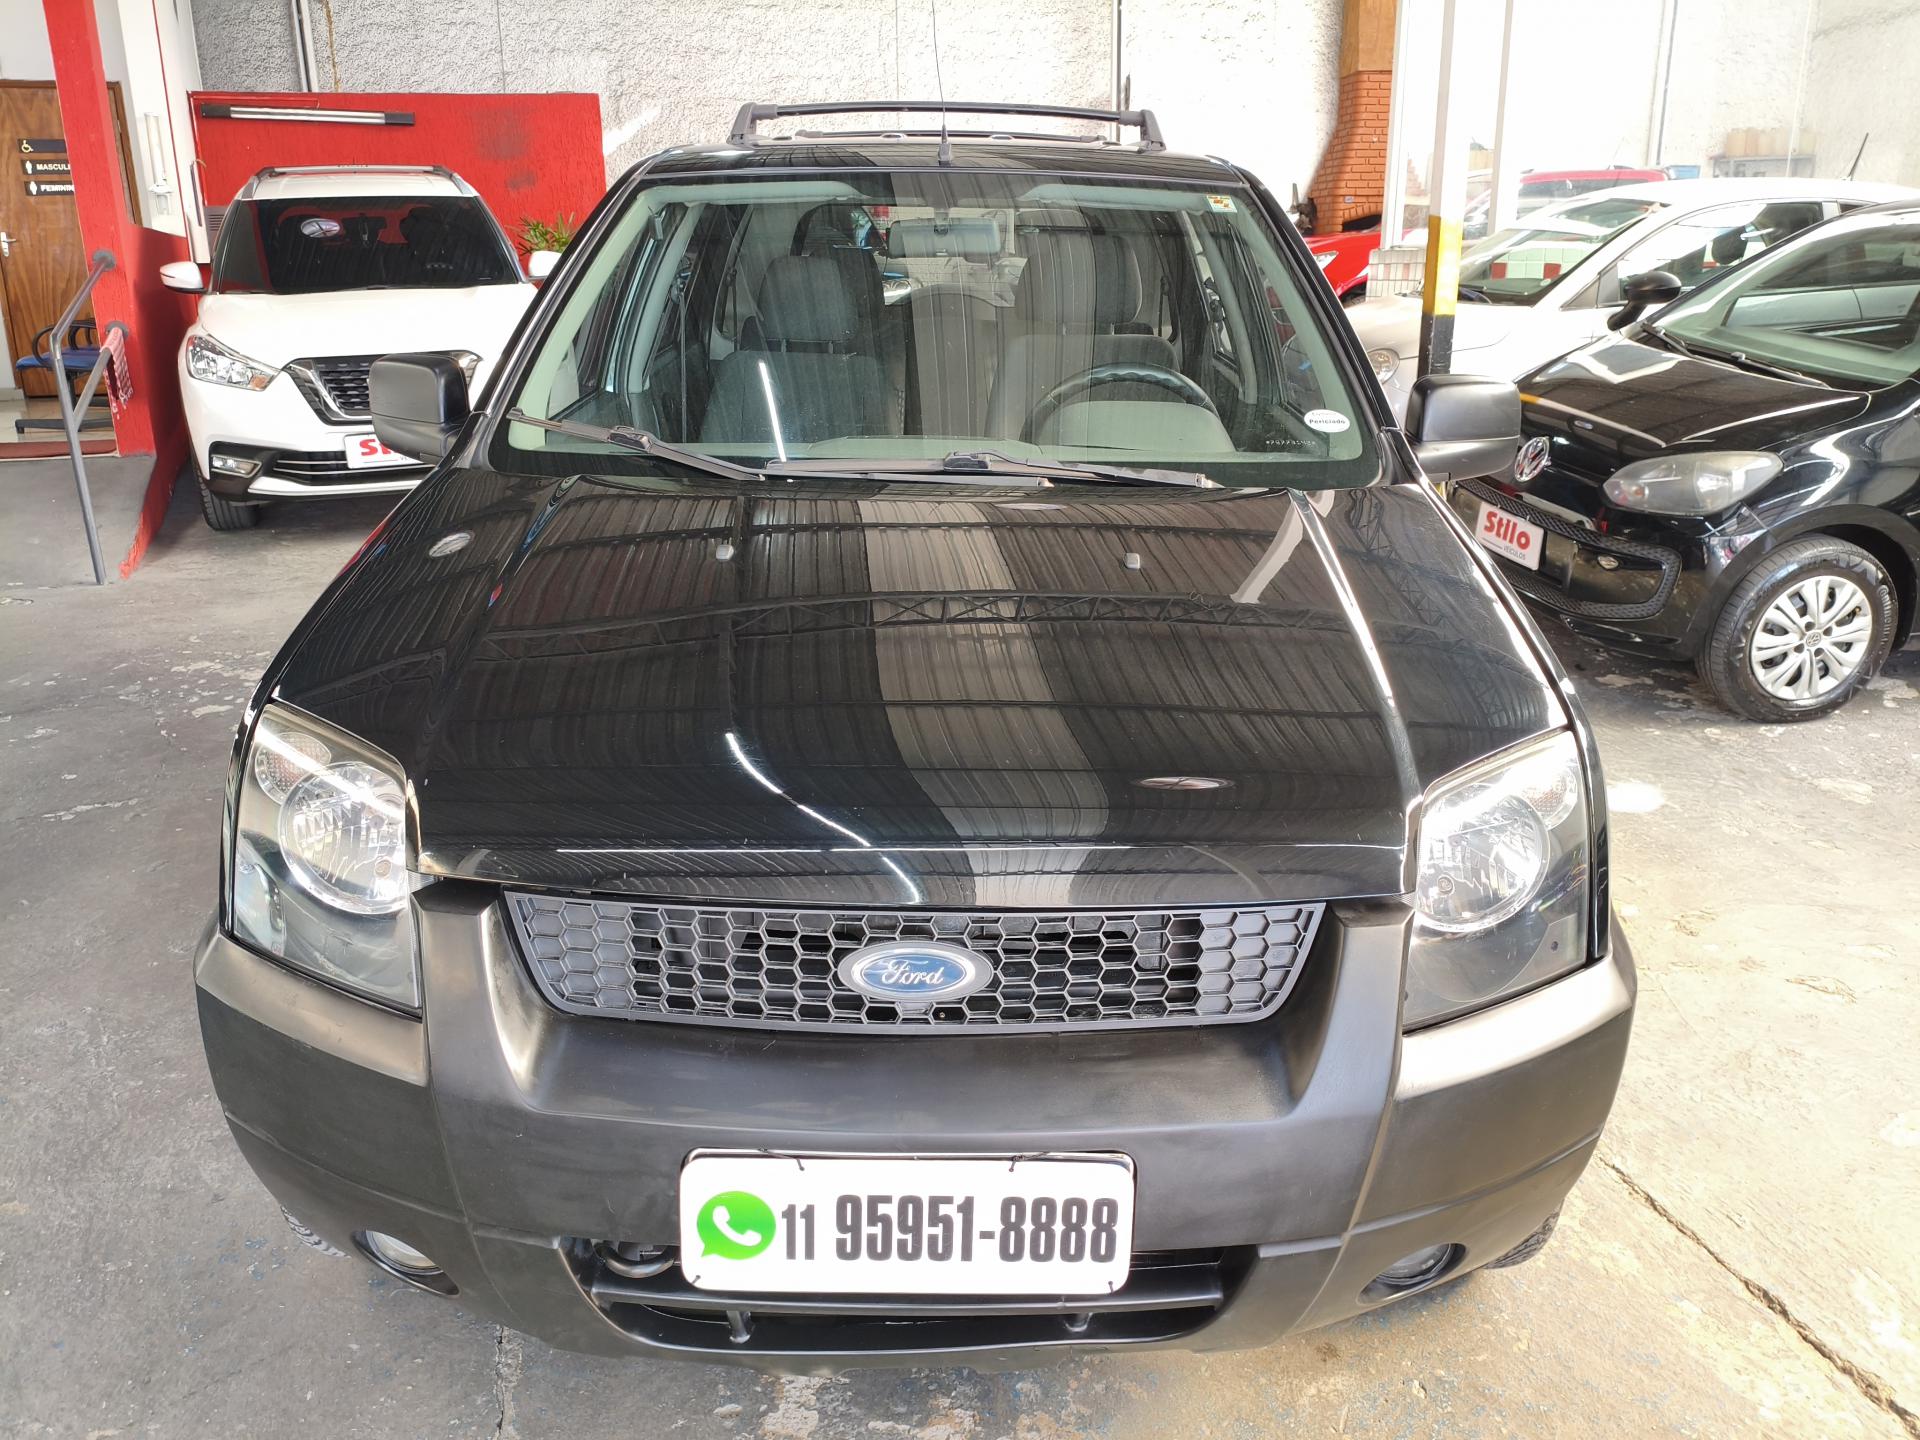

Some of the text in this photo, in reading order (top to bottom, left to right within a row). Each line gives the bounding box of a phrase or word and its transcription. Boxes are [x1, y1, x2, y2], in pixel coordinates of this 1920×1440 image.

[1484, 511, 1531, 550] Stilo
[881, 959, 944, 985] Ford
[781, 1194, 1119, 1263] 11 95951-8888
